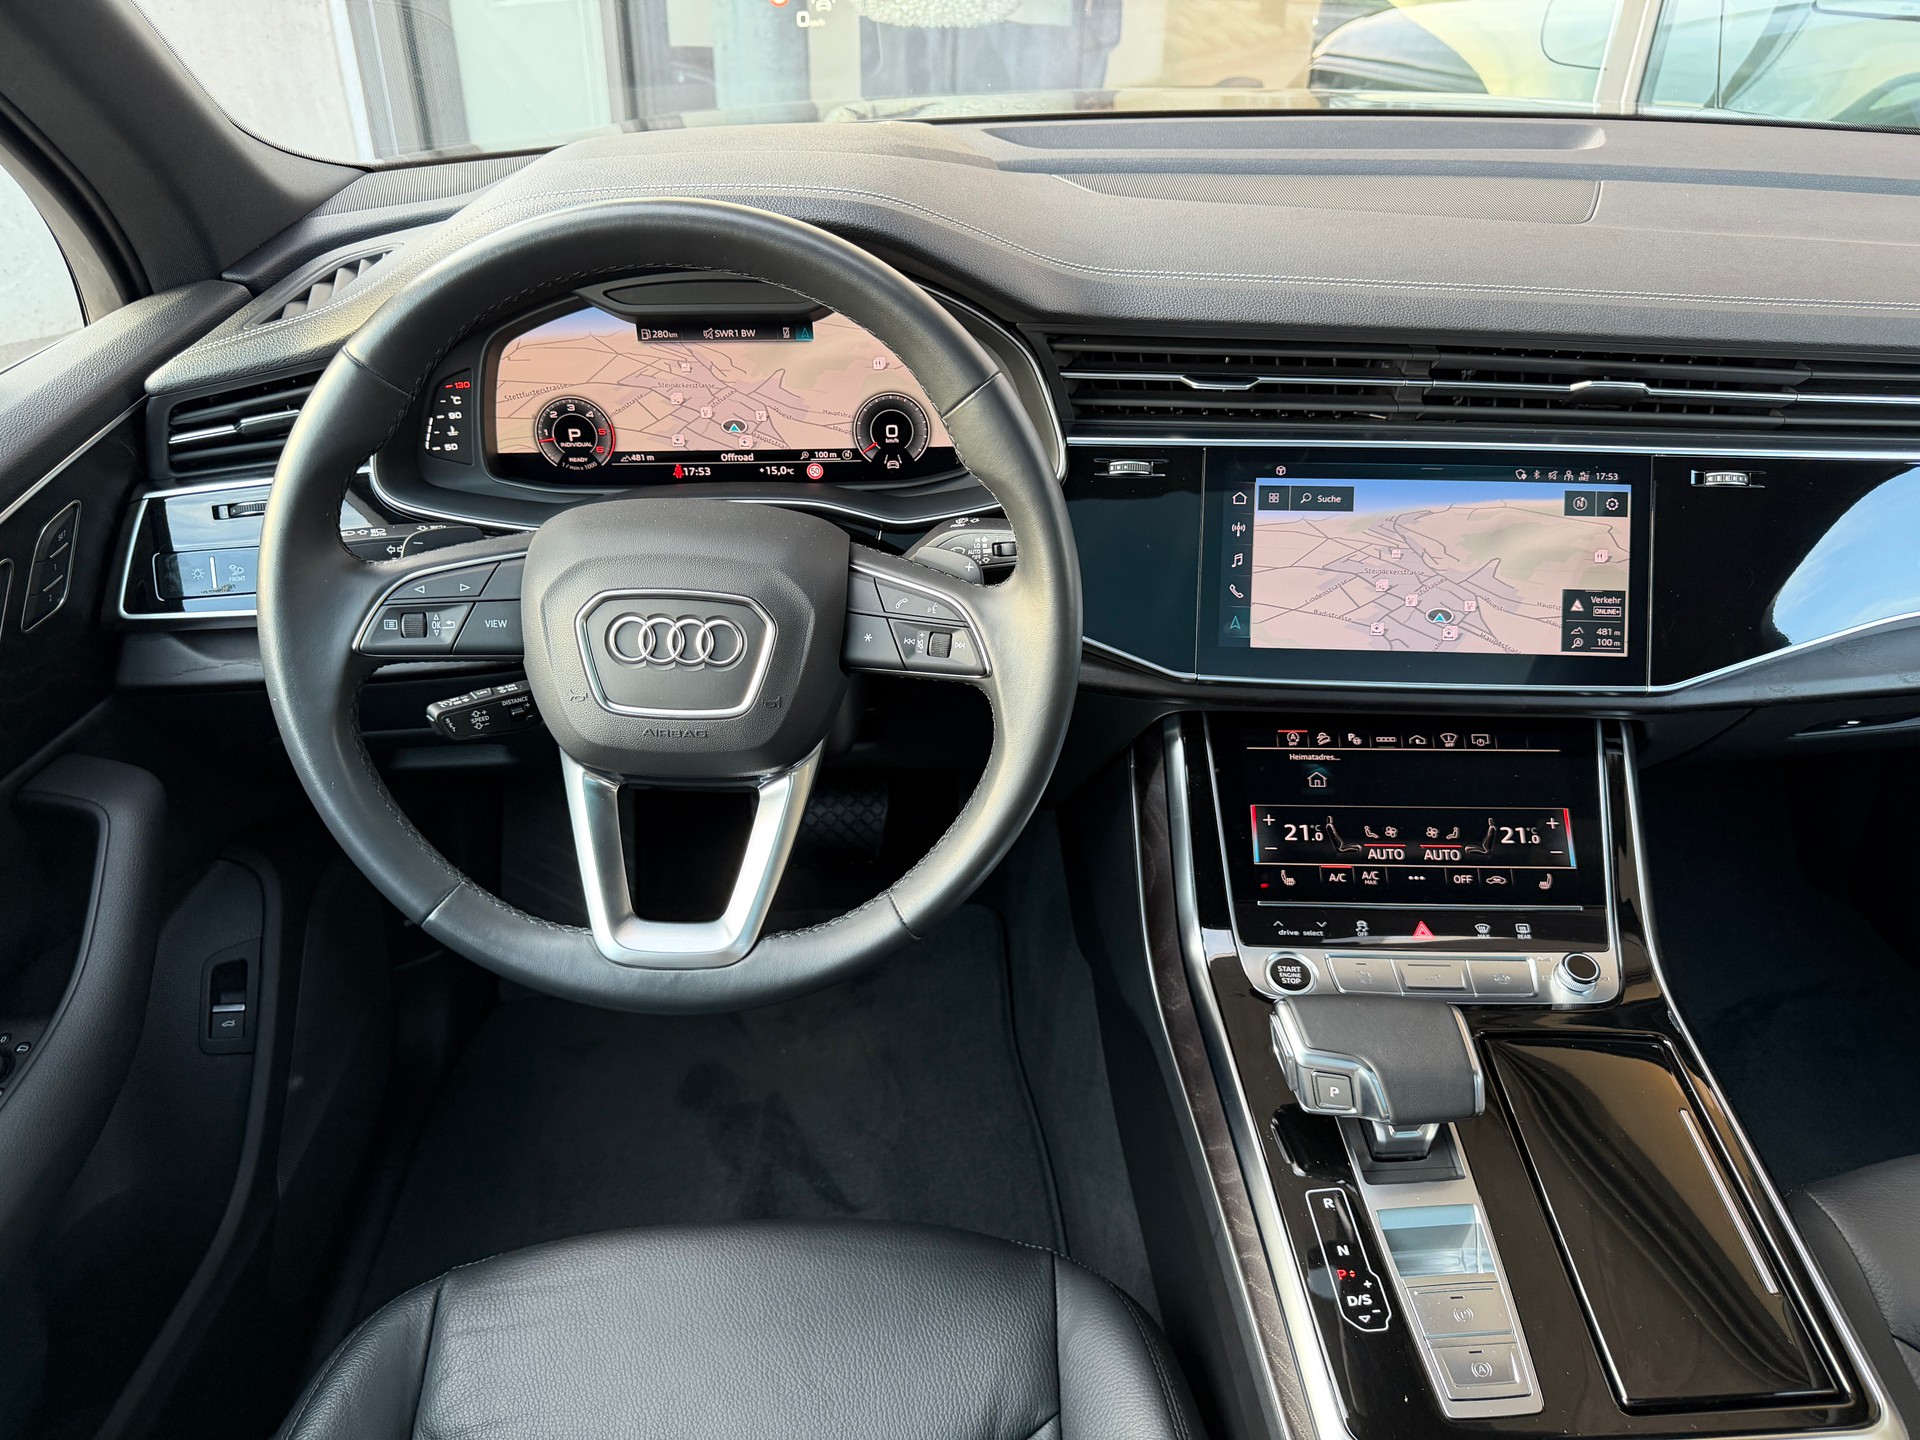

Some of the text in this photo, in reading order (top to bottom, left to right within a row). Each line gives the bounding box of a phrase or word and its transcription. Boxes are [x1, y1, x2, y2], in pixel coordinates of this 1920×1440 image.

[796, 10, 810, 28] 0
[714, 328, 756, 338] SWR1 BW
[454, 381, 471, 389] 130
[566, 403, 576, 412] 3
[549, 410, 559, 419] 2
[585, 410, 595, 418] 4
[567, 428, 582, 442] P
[598, 428, 608, 436] 5
[885, 424, 899, 438] 0
[444, 443, 459, 451] 50
[595, 445, 605, 454] 6
[631, 453, 646, 462] 481
[720, 452, 755, 462] Offroad
[814, 451, 829, 459] 100
[683, 467, 712, 477] 17:53
[809, 465, 821, 476] 50
[1595, 472, 1619, 482] 17:53
[1317, 494, 1342, 504] Suche
[1590, 595, 1622, 605] Verkehr
[431, 620, 442, 630] OK
[484, 618, 508, 629] VIEW
[1596, 627, 1612, 636] 481
[1597, 638, 1613, 647] 100
[501, 696, 529, 706] DISTANCE
[471, 715, 490, 724] SPEED
[642, 728, 709, 739] AIRBAG
[1367, 848, 1406, 860] AUTO
[1423, 849, 1462, 861] AUTO
[1328, 873, 1347, 883] A/C
[1361, 871, 1380, 880] A/C
[1453, 874, 1474, 885] OFF
[1277, 965, 1302, 973] START
[1279, 971, 1302, 979] ENGINE
[1281, 976, 1302, 985] STOP
[1329, 1086, 1339, 1098] P
[1323, 1198, 1336, 1209] R
[1336, 1244, 1350, 1257] N
[1336, 1269, 1348, 1280] P
[1346, 1293, 1373, 1307] D/S
